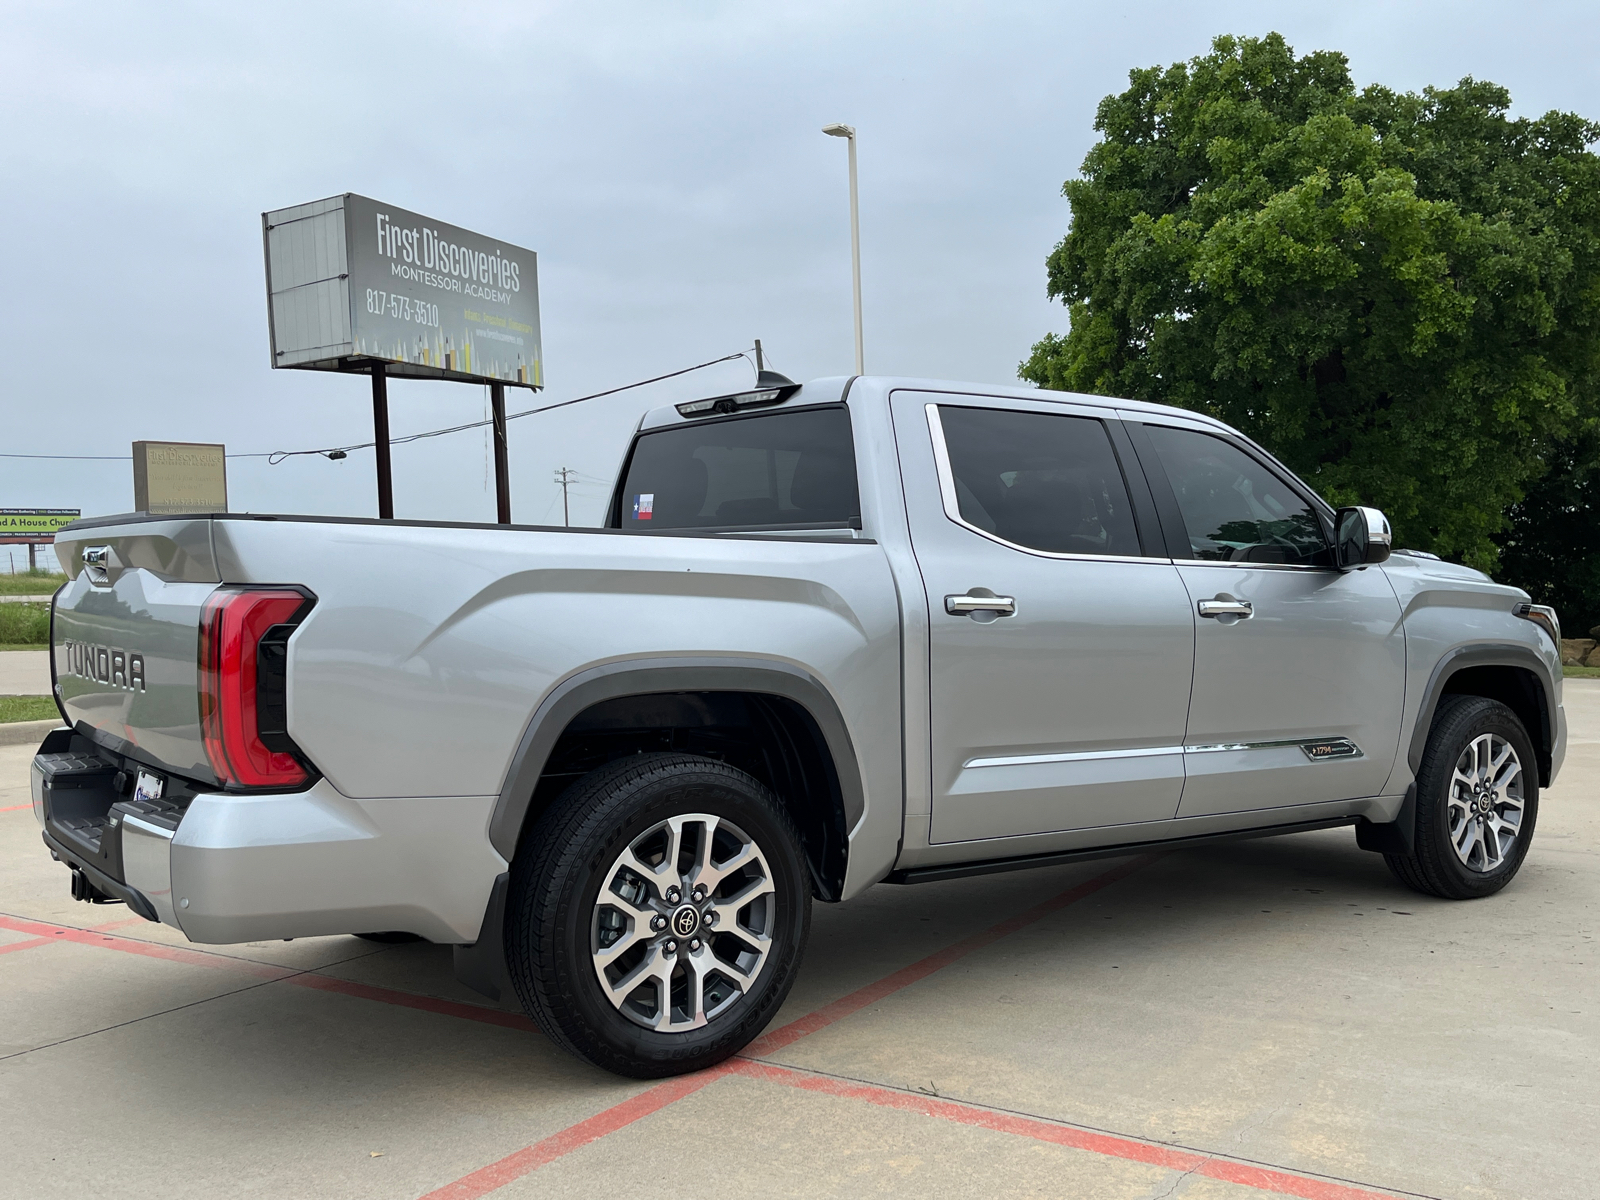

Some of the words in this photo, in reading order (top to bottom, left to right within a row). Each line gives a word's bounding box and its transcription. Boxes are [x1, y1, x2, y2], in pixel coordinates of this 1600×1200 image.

[376, 212, 420, 266] First
[423, 227, 520, 293] Discoveries
[391, 262, 462, 293] MONTESSORI
[464, 283, 512, 305] ACADEMY
[366, 288, 439, 328] 817-573-3510
[10, 518, 17, 527] A
[19, 518, 48, 527] House
[49, 518, 76, 527] Chur
[65, 638, 146, 693] TUNDRA
[1316, 745, 1332, 755] 1794
